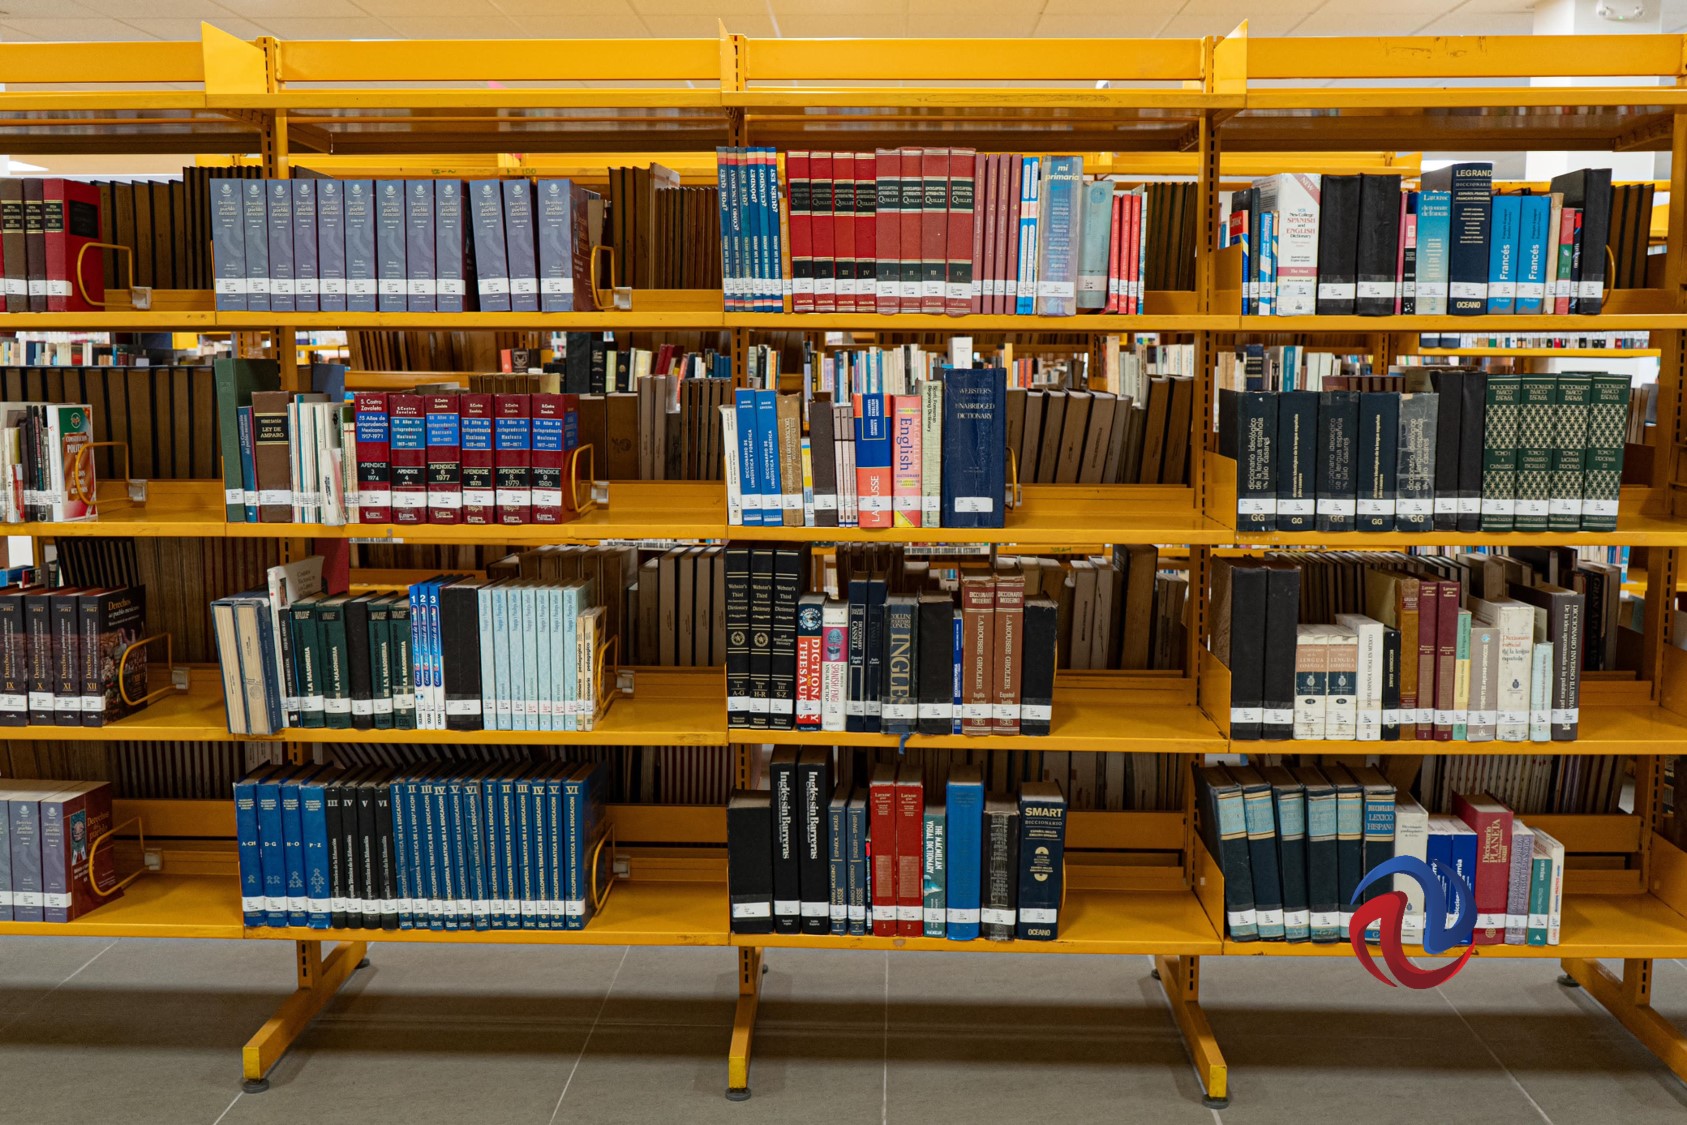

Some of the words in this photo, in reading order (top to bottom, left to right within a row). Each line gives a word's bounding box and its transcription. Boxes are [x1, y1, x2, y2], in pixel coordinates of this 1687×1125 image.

[1045, 174, 1080, 182] primaria
[1301, 176, 1314, 191] NEW
[771, 186, 779, 213] ¿QUIÉN
[1500, 244, 1510, 280] Francés
[1529, 244, 1539, 280] Francés
[1457, 301, 1480, 309] OCEANO
[1249, 418, 1257, 451] ideológico
[896, 418, 913, 471] English
[1255, 449, 1263, 472] lengua
[1262, 466, 1270, 480] julio
[1255, 481, 1262, 490] de
[1251, 514, 1265, 522] GG
[420, 595, 426, 603] 2
[1564, 604, 1571, 613] De
[1571, 604, 1579, 650] DICCIONARIO
[799, 641, 808, 720] THESAURS
[811, 639, 820, 721] DICTIONY
[395, 786, 399, 794] I
[408, 785, 416, 793] II
[421, 785, 433, 794] III
[434, 786, 446, 795] IV
[450, 785, 460, 794] V
[466, 786, 477, 794] VI
[487, 785, 493, 793] I
[502, 785, 511, 793] II
[517, 785, 528, 793] III
[533, 786, 545, 795] IV
[549, 786, 560, 794] V
[566, 786, 579, 794] VI
[780, 771, 791, 801] Inglés
[808, 771, 819, 801] Inglés
[782, 801, 791, 816] sin
[810, 801, 819, 816] sin
[1025, 808, 1063, 817] SMART
[926, 821, 934, 840] VISUAL
[935, 826, 943, 837] THE
[783, 817, 791, 859] Barreras
[811, 817, 820, 860] Barreras
[1483, 827, 1491, 863] Diccionario
[1490, 819, 1501, 863] PLANETA
[926, 840, 934, 874] DICTIONARY
[935, 838, 943, 870] MACMILLAN
